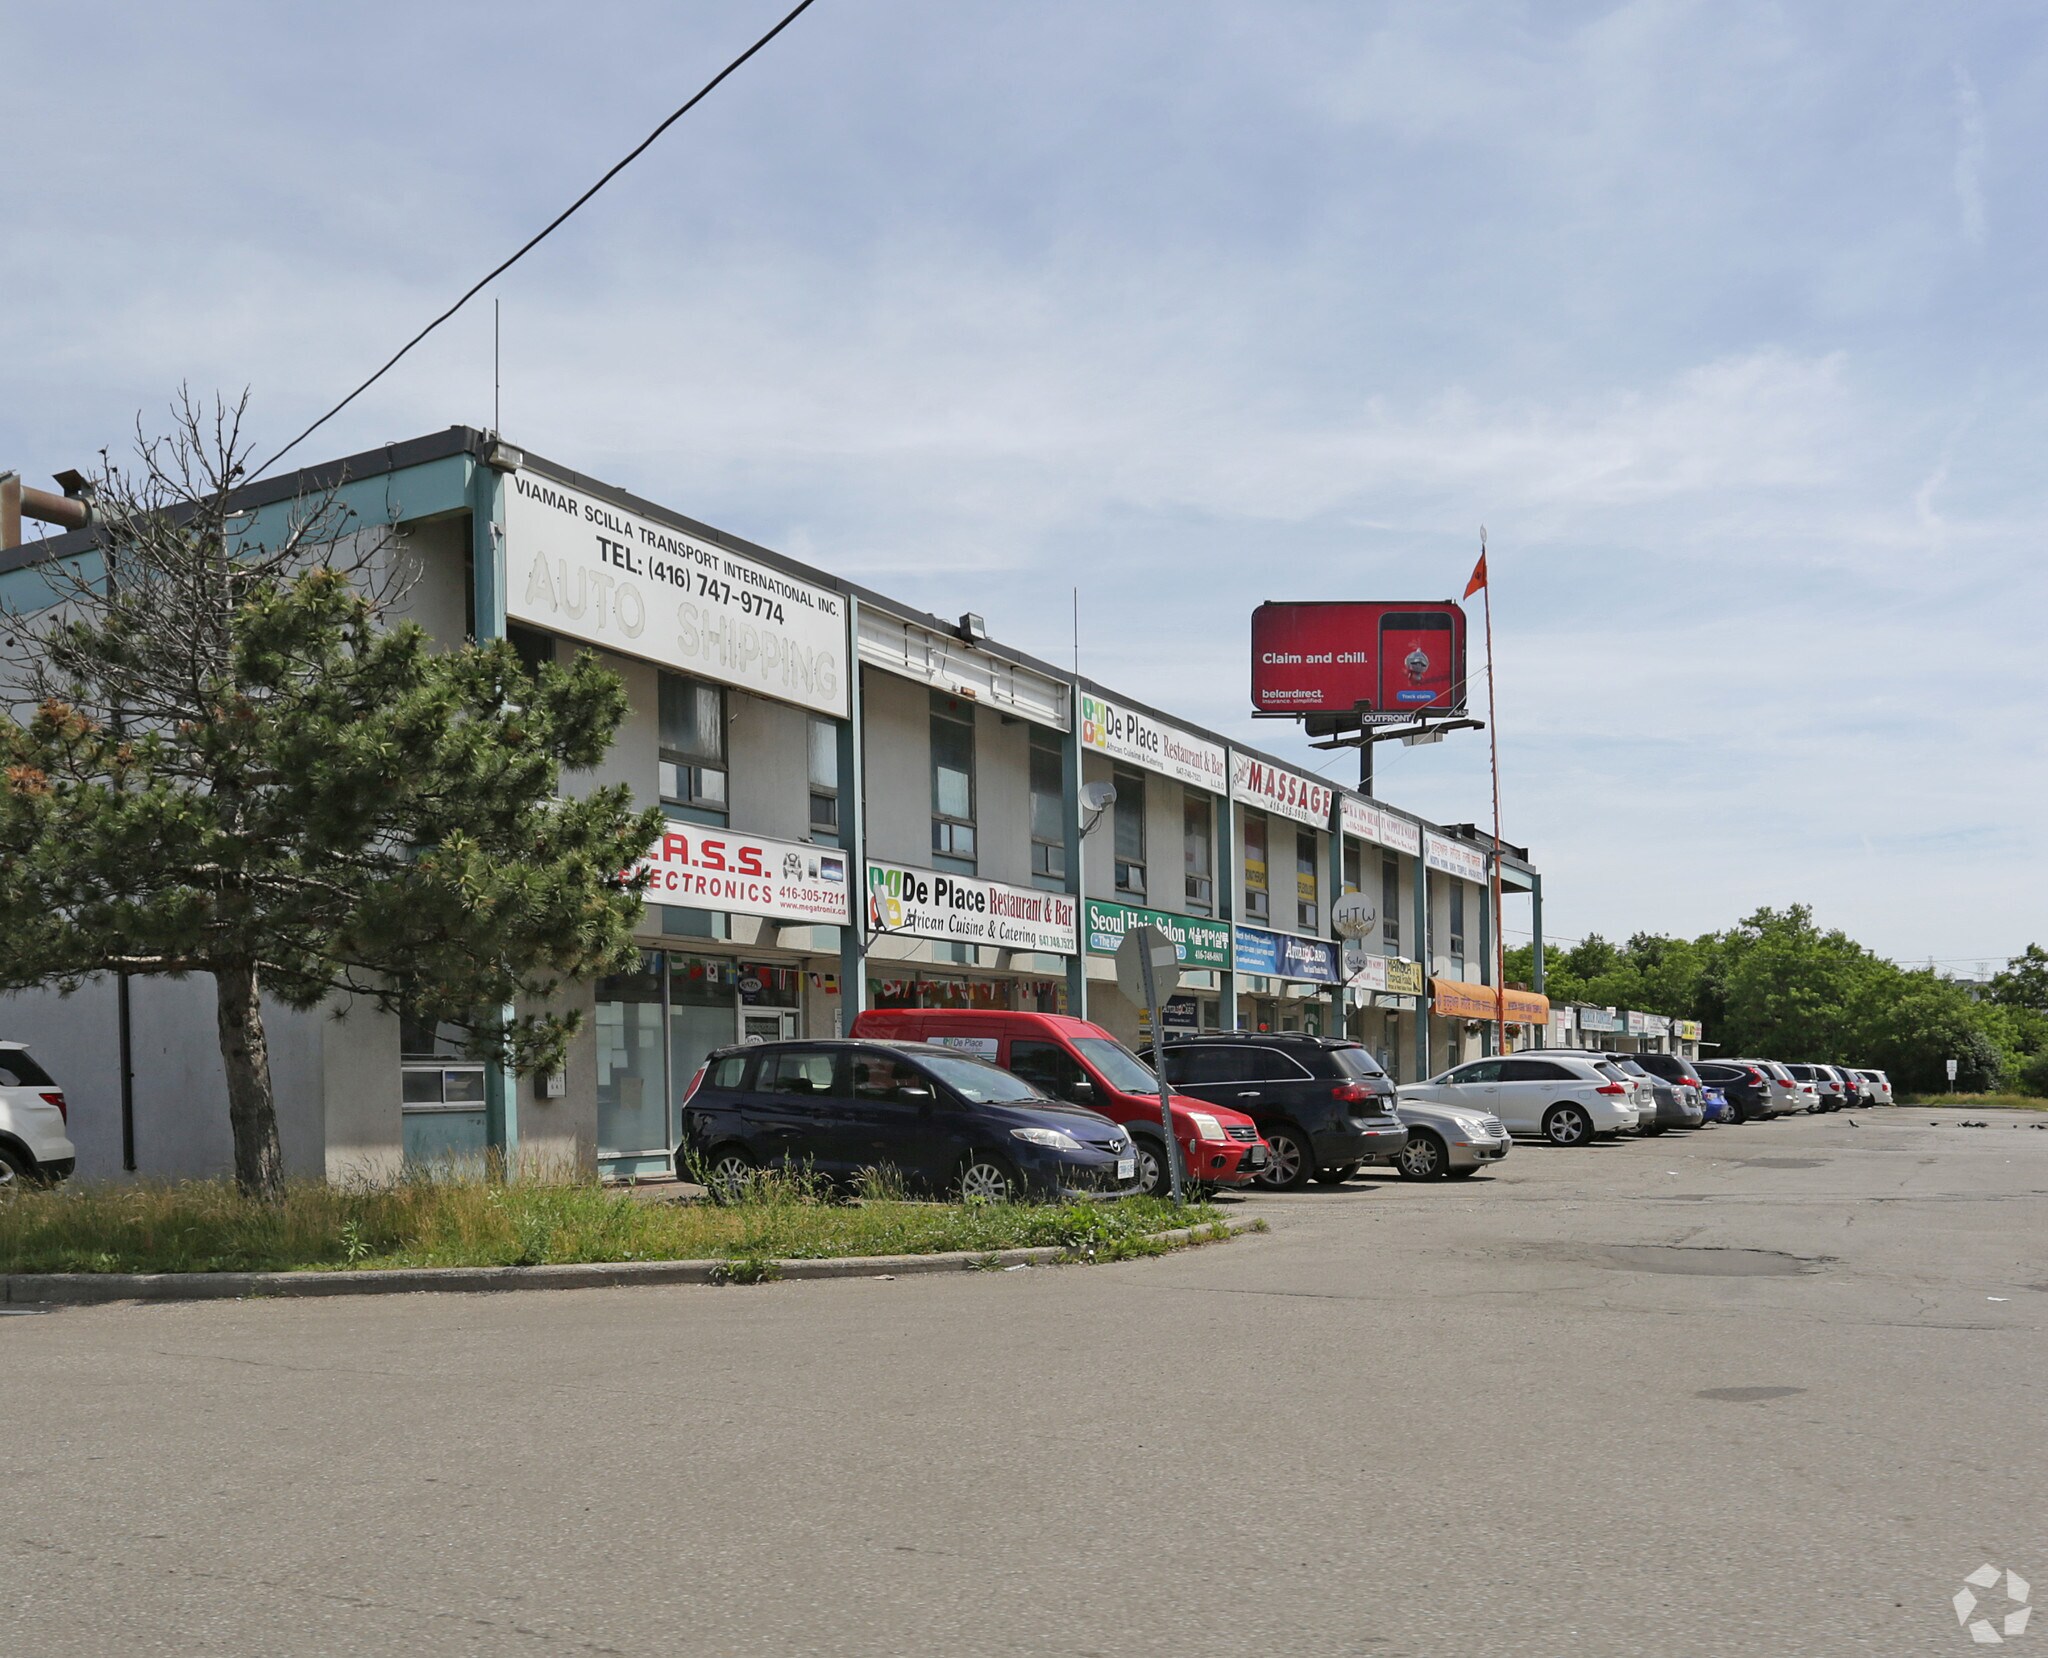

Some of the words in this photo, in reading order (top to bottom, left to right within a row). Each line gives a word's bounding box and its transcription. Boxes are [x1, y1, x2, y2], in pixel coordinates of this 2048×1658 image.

[515, 476, 579, 517] VIAMAR
[585, 504, 634, 539] SCILLA
[638, 526, 720, 571] TRANSPORT
[723, 560, 814, 608] INTERNATIONAL
[818, 596, 840, 617] INC.
[596, 535, 643, 575] TEL:
[648, 556, 691, 593] (416)
[696, 572, 785, 625] 747-9774
[525, 550, 646, 639] AUTO
[676, 601, 837, 700] SHIPPING
[1262, 652, 1301, 664] Claim
[1305, 652, 1332, 664] and
[1336, 651, 1368, 664] chill.
[1364, 714, 1412, 723] OUTFRONT
[1106, 705, 1122, 739] De
[1126, 714, 1158, 753] Place
[1163, 735, 1204, 770] Restaurant
[1204, 754, 1210, 772] &
[1211, 752, 1223, 777] Bar
[1248, 761, 1330, 817] MASSAGE
[640, 833, 771, 878] .A.S.S.
[779, 886, 845, 905] 416-305-7211
[780, 902, 846, 915] www.megatronix.ca
[902, 871, 928, 904] De
[934, 877, 985, 913] Place
[989, 887, 1042, 922] Restaurant
[1044, 901, 1052, 923] &
[1055, 903, 1073, 927] Bar
[949, 914, 984, 936] Cuisine
[988, 919, 996, 938] &
[999, 921, 1036, 948] Catering
[1091, 906, 1125, 933] Seoul
[1156, 917, 1186, 943] Salon
[1339, 907, 1375, 922] HTW
[953, 1038, 963, 1046] De
[964, 1038, 984, 1048] Place
